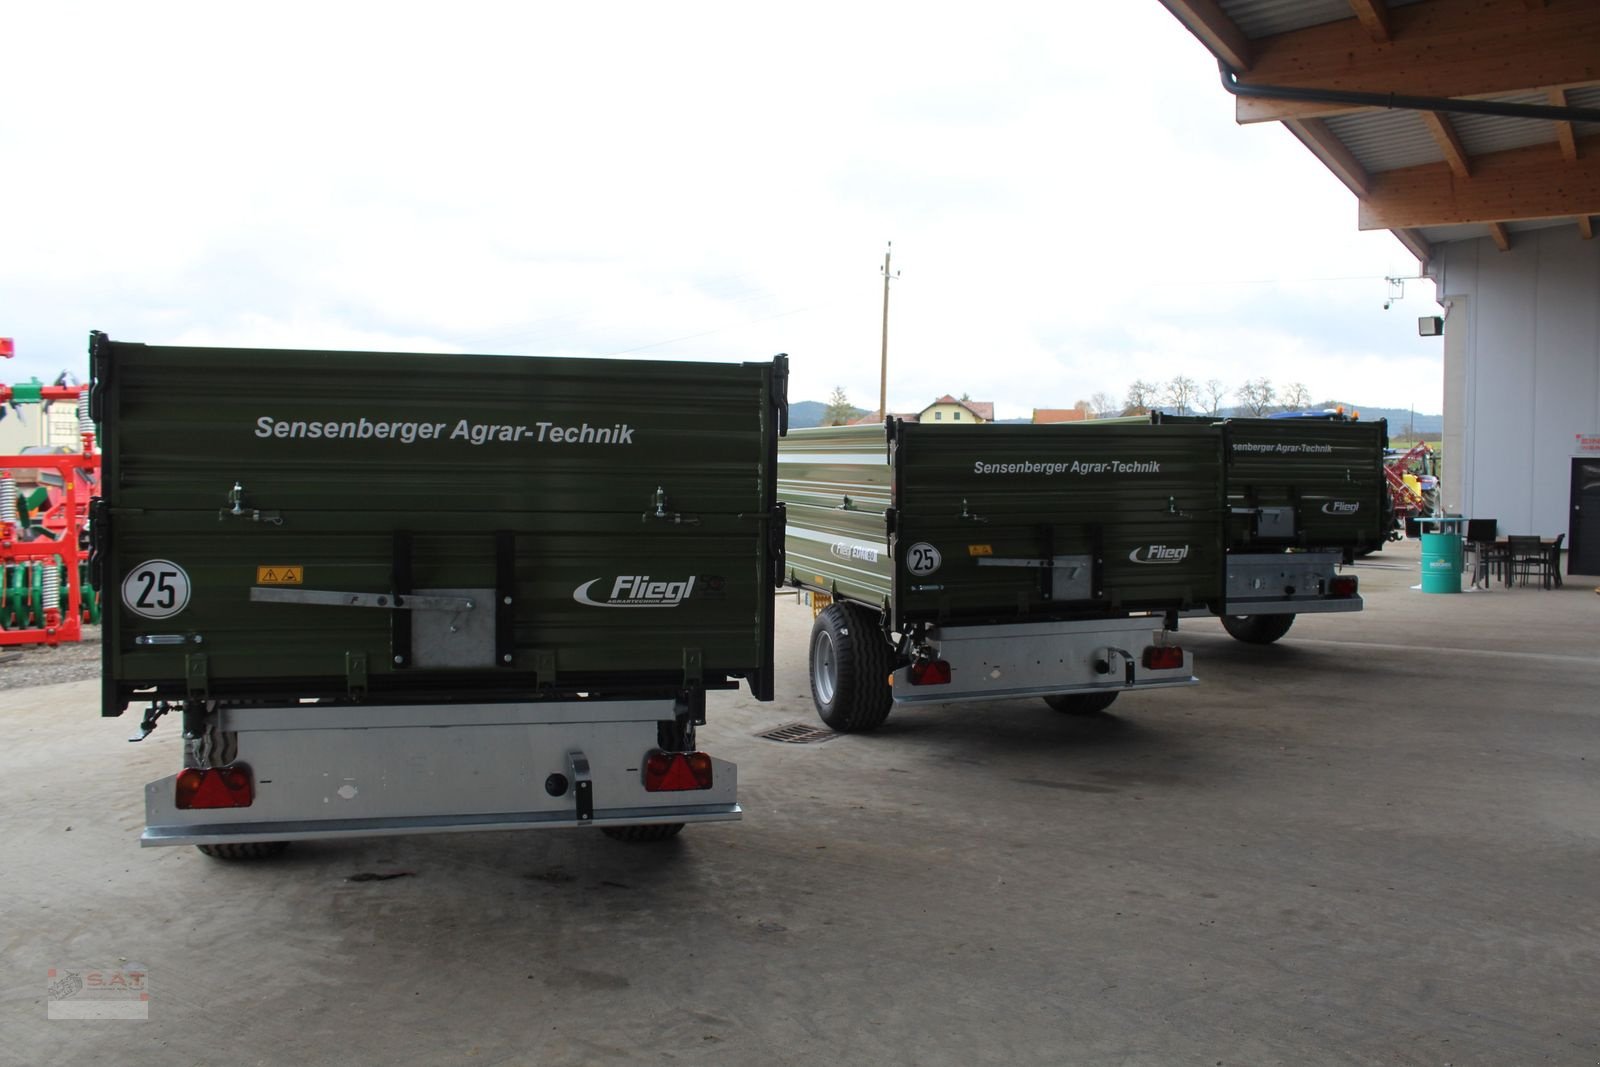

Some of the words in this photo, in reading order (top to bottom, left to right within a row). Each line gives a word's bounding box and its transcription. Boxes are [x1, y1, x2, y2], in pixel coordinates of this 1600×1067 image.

[255, 416, 446, 444] Sensenberger
[450, 419, 635, 445] Agrar-Technik
[1231, 442, 1275, 454] senberger
[1275, 443, 1333, 455] Agrar-Technik
[974, 460, 1068, 476] Sensenberger
[1070, 460, 1161, 476] Agrar-Technik
[1332, 501, 1360, 513] Fliegl
[913, 549, 933, 570] 25
[1147, 544, 1189, 561] Fliegl
[136, 570, 177, 609] 25
[610, 575, 696, 603] Fliegl
